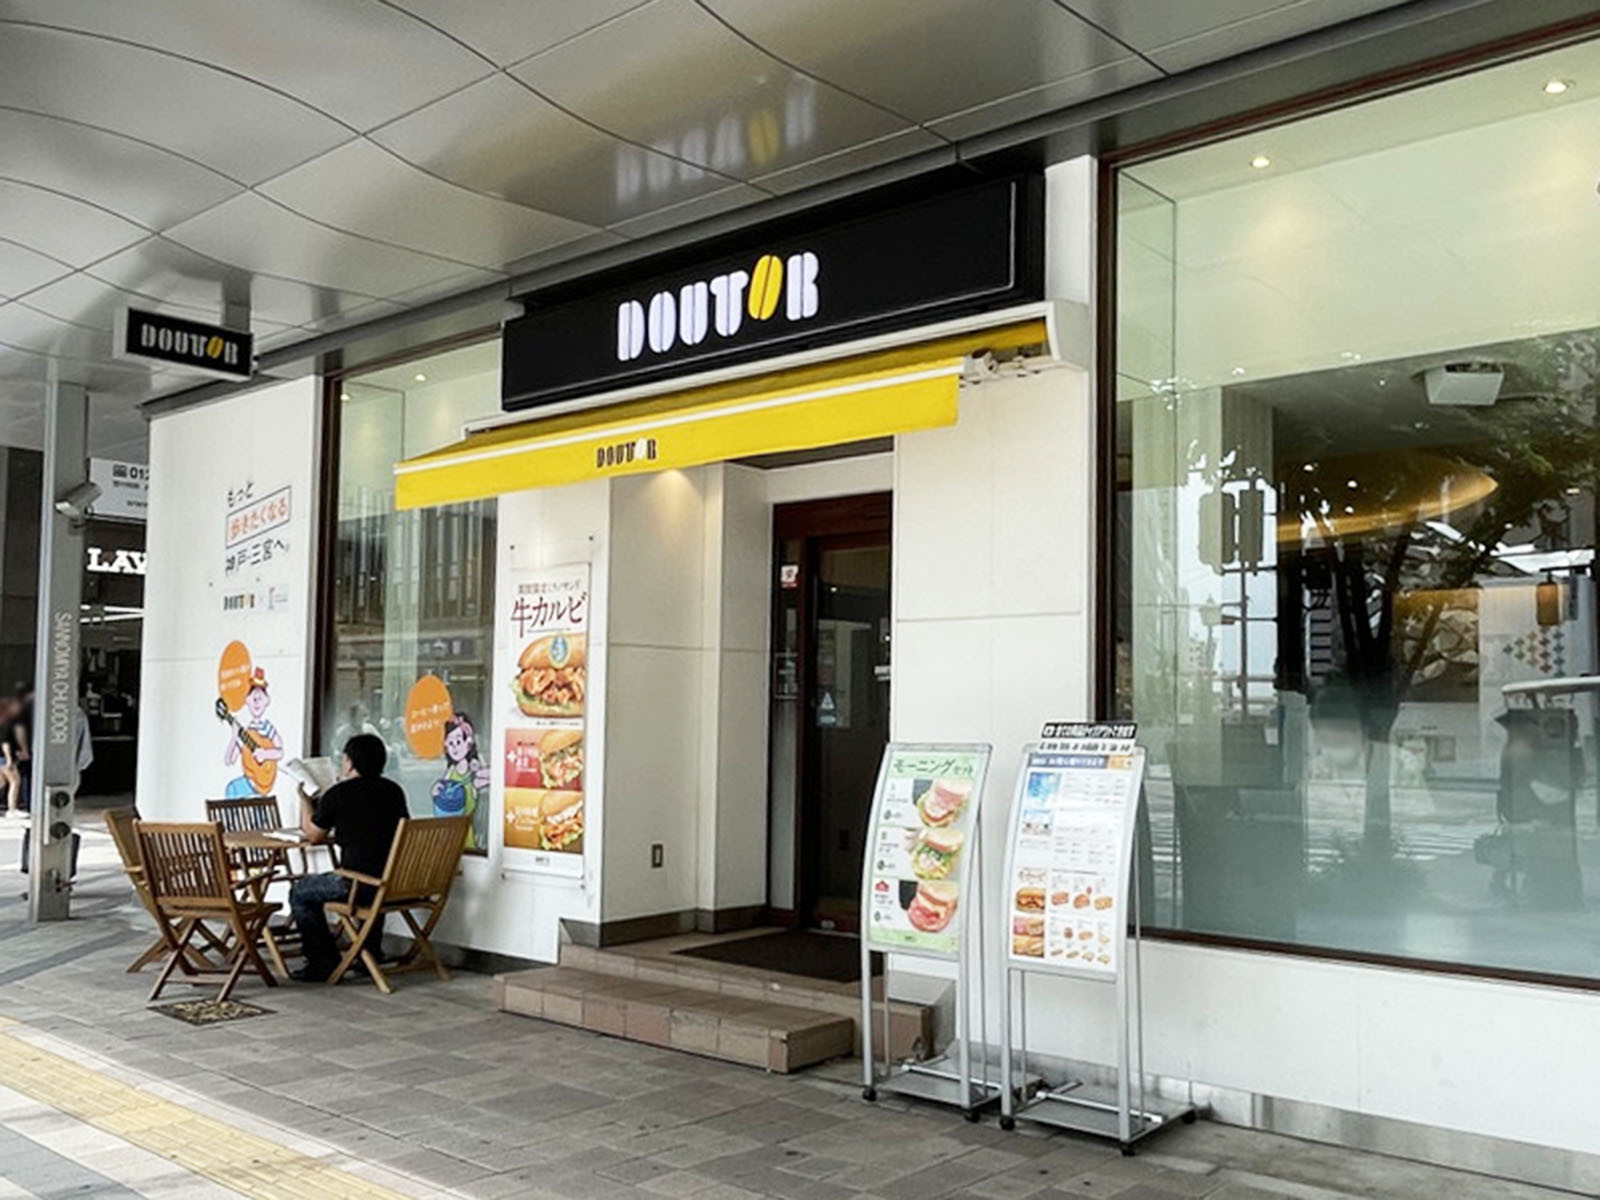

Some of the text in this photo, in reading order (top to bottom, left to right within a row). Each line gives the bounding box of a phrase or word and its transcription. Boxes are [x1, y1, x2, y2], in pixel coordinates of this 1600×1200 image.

[617, 251, 820, 362] DOUTOR
[141, 323, 238, 365] DOUTOR
[597, 438, 656, 468] DOUTOR
[510, 591, 588, 638] 牛カルビ
